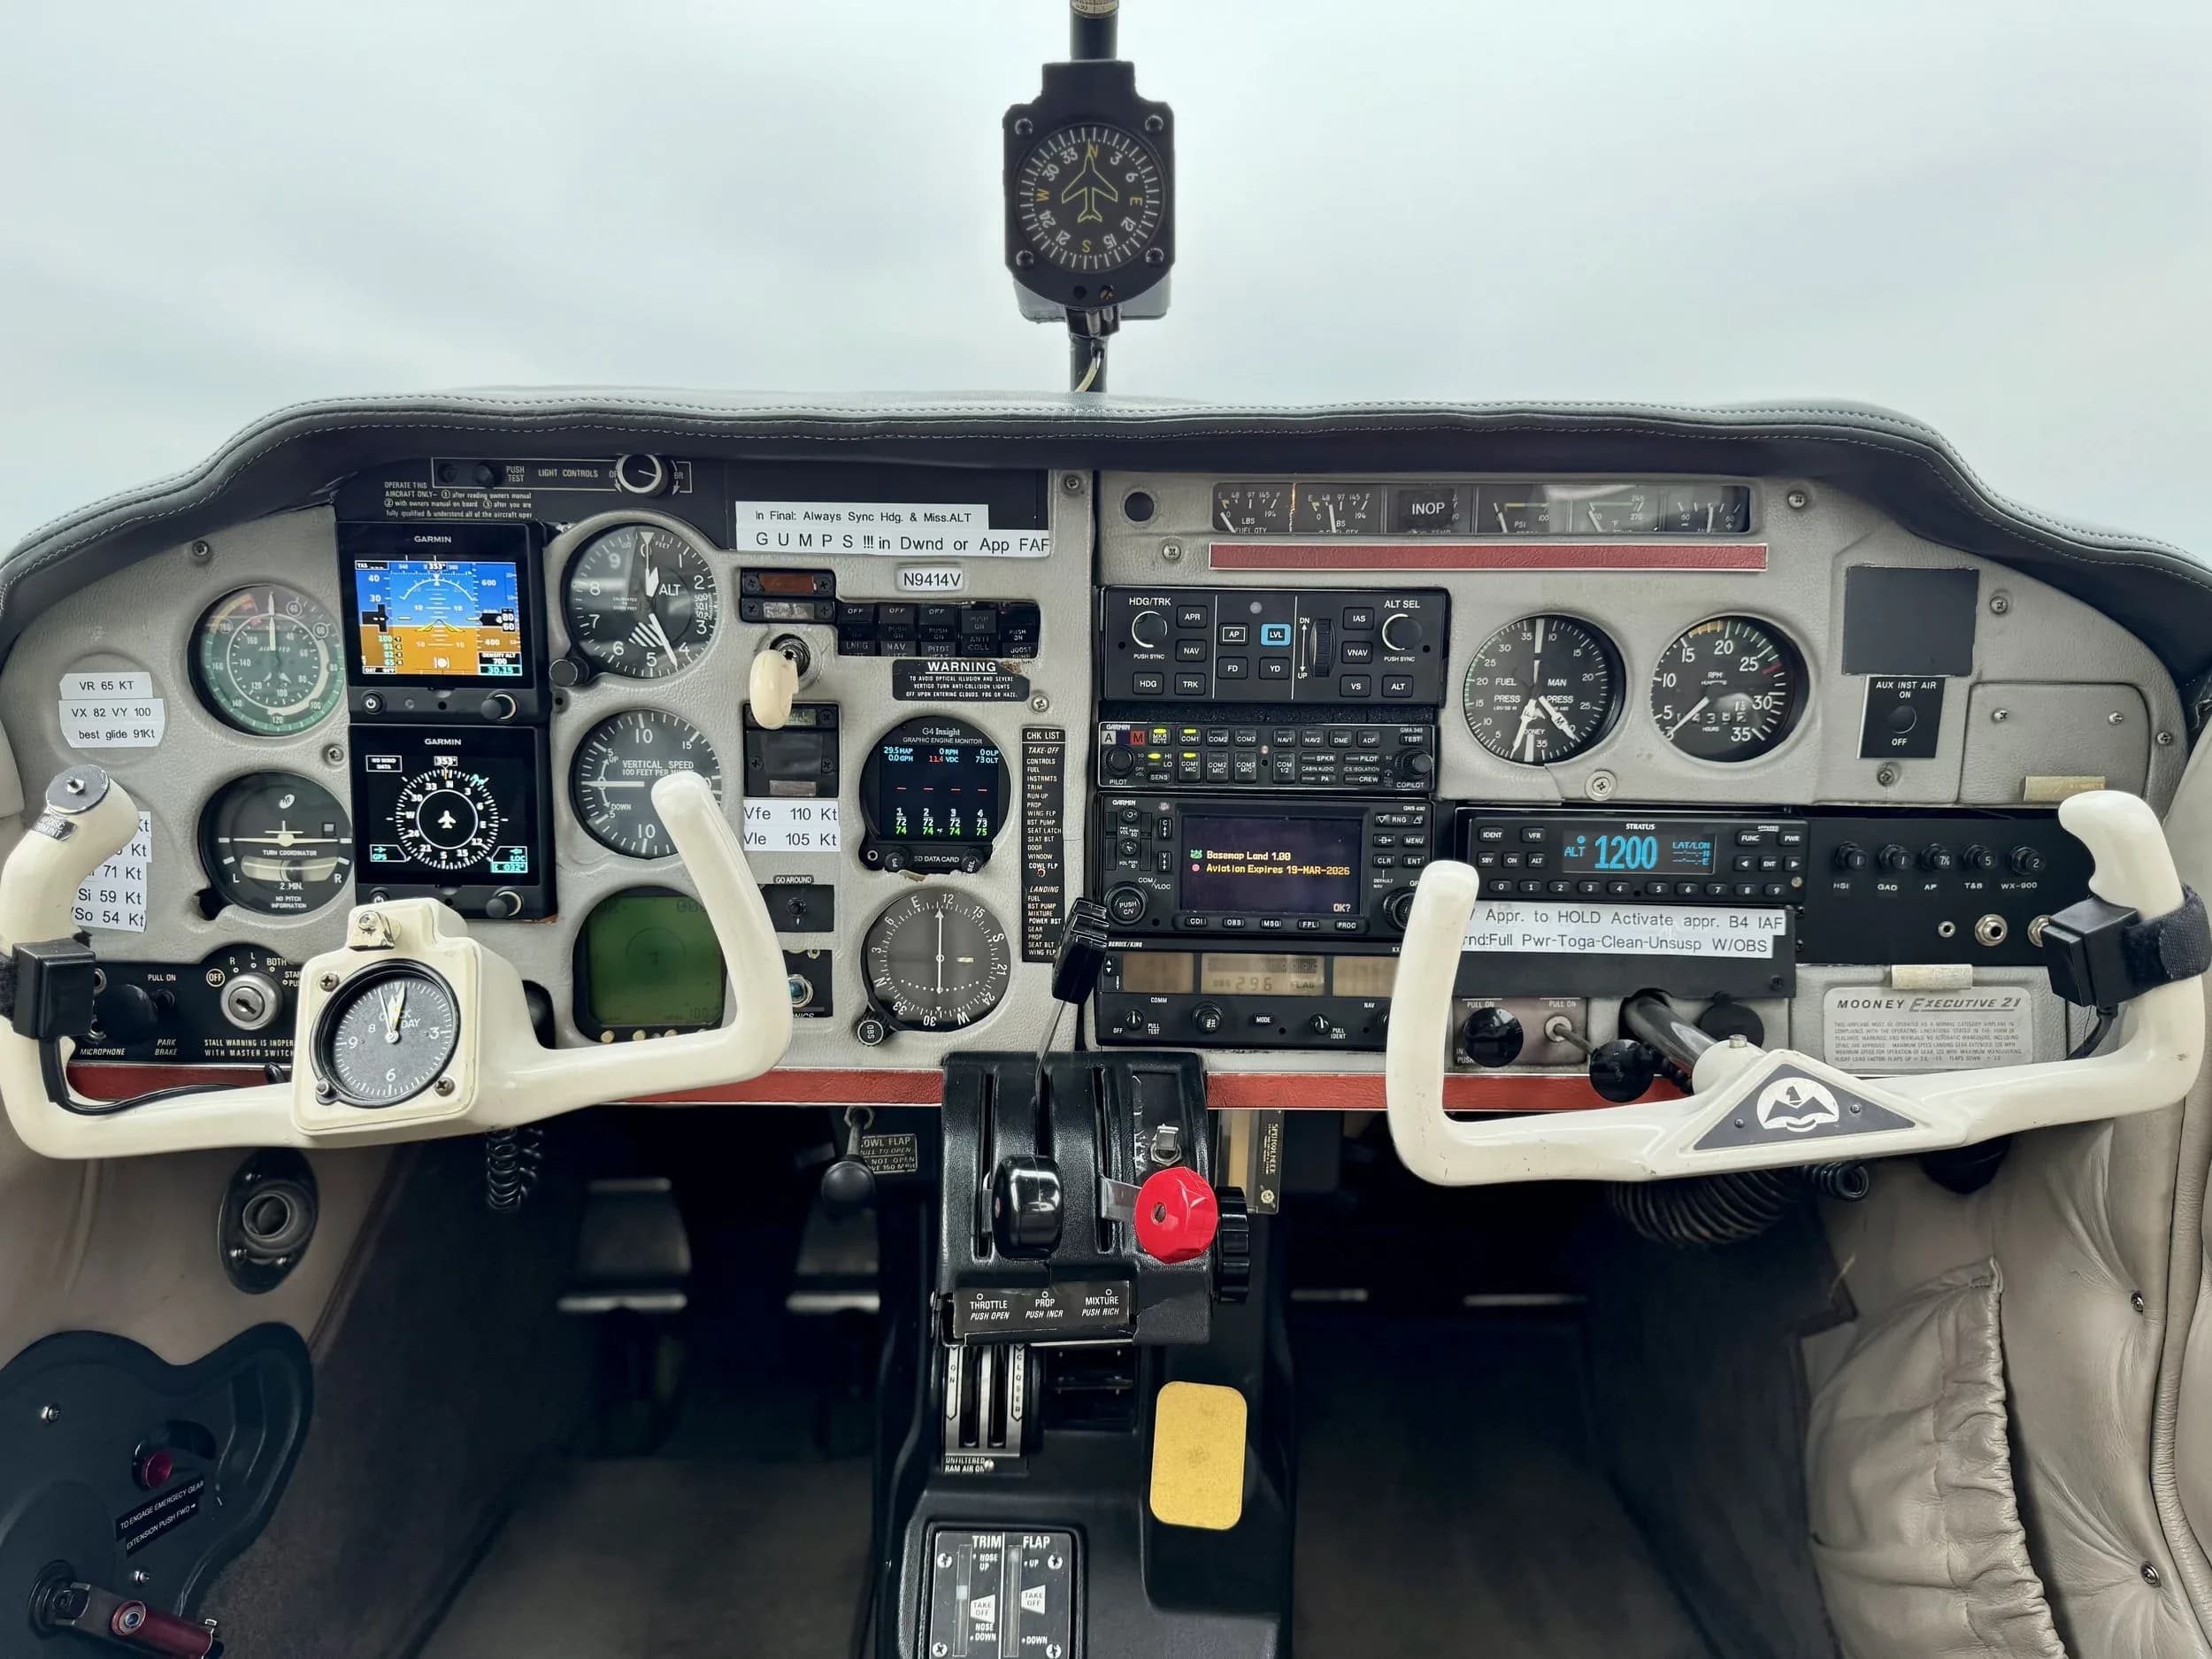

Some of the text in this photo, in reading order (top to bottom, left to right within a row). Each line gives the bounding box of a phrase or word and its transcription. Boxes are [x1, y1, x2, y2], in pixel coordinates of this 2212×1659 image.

[1412, 503, 1444, 515] INOP
[756, 511, 764, 520] In
[770, 511, 796, 520] Final:
[803, 511, 841, 522] Always
[848, 511, 874, 523] Sync
[881, 512, 902, 523] Hdg.
[924, 512, 972, 522] Miss.ALT
[756, 533, 1048, 555] G U M P S !!! in Dwnd or App FAF
[903, 573, 960, 587] N9414V
[1385, 600, 1400, 609] ALT
[928, 662, 996, 672] WARNING
[80, 681, 95, 690] VR
[102, 681, 113, 690] 65
[112, 708, 127, 717] VY
[106, 730, 127, 741] glide
[744, 807, 837, 820] Vfe 110 Kt
[786, 833, 810, 845] 105
[820, 833, 836, 846] Kt
[1207, 850, 1290, 862] Basemap Land 1.00
[1564, 835, 1657, 869] ALT 1200
[104, 865, 142, 880] 71 Kt
[1207, 864, 1242, 873] Aviation
[1246, 864, 1283, 875] Expires
[79, 888, 142, 904] Si 59 Kt
[1333, 903, 1350, 912] OK?
[103, 911, 144, 926] 54 Kt
[1486, 910, 1783, 930] Appr. to HOLD Activate appr. B4 IAF
[1523, 934, 1767, 952] Pwr-Toga-Clean-Unsusp W/OBS
[1838, 1000, 1904, 1009] MOONEY
[970, 1301, 1007, 1310] THROTTLE
[1086, 1296, 1118, 1305] MIXTURE
[120, 1480, 204, 1530] TO ENGAGE EMERGECY GEAR
[127, 1505, 190, 1549] EXTENSION PUSH FWD
[972, 1536, 1002, 1548] TRIM
[1024, 1536, 1049, 1548] FLAP
